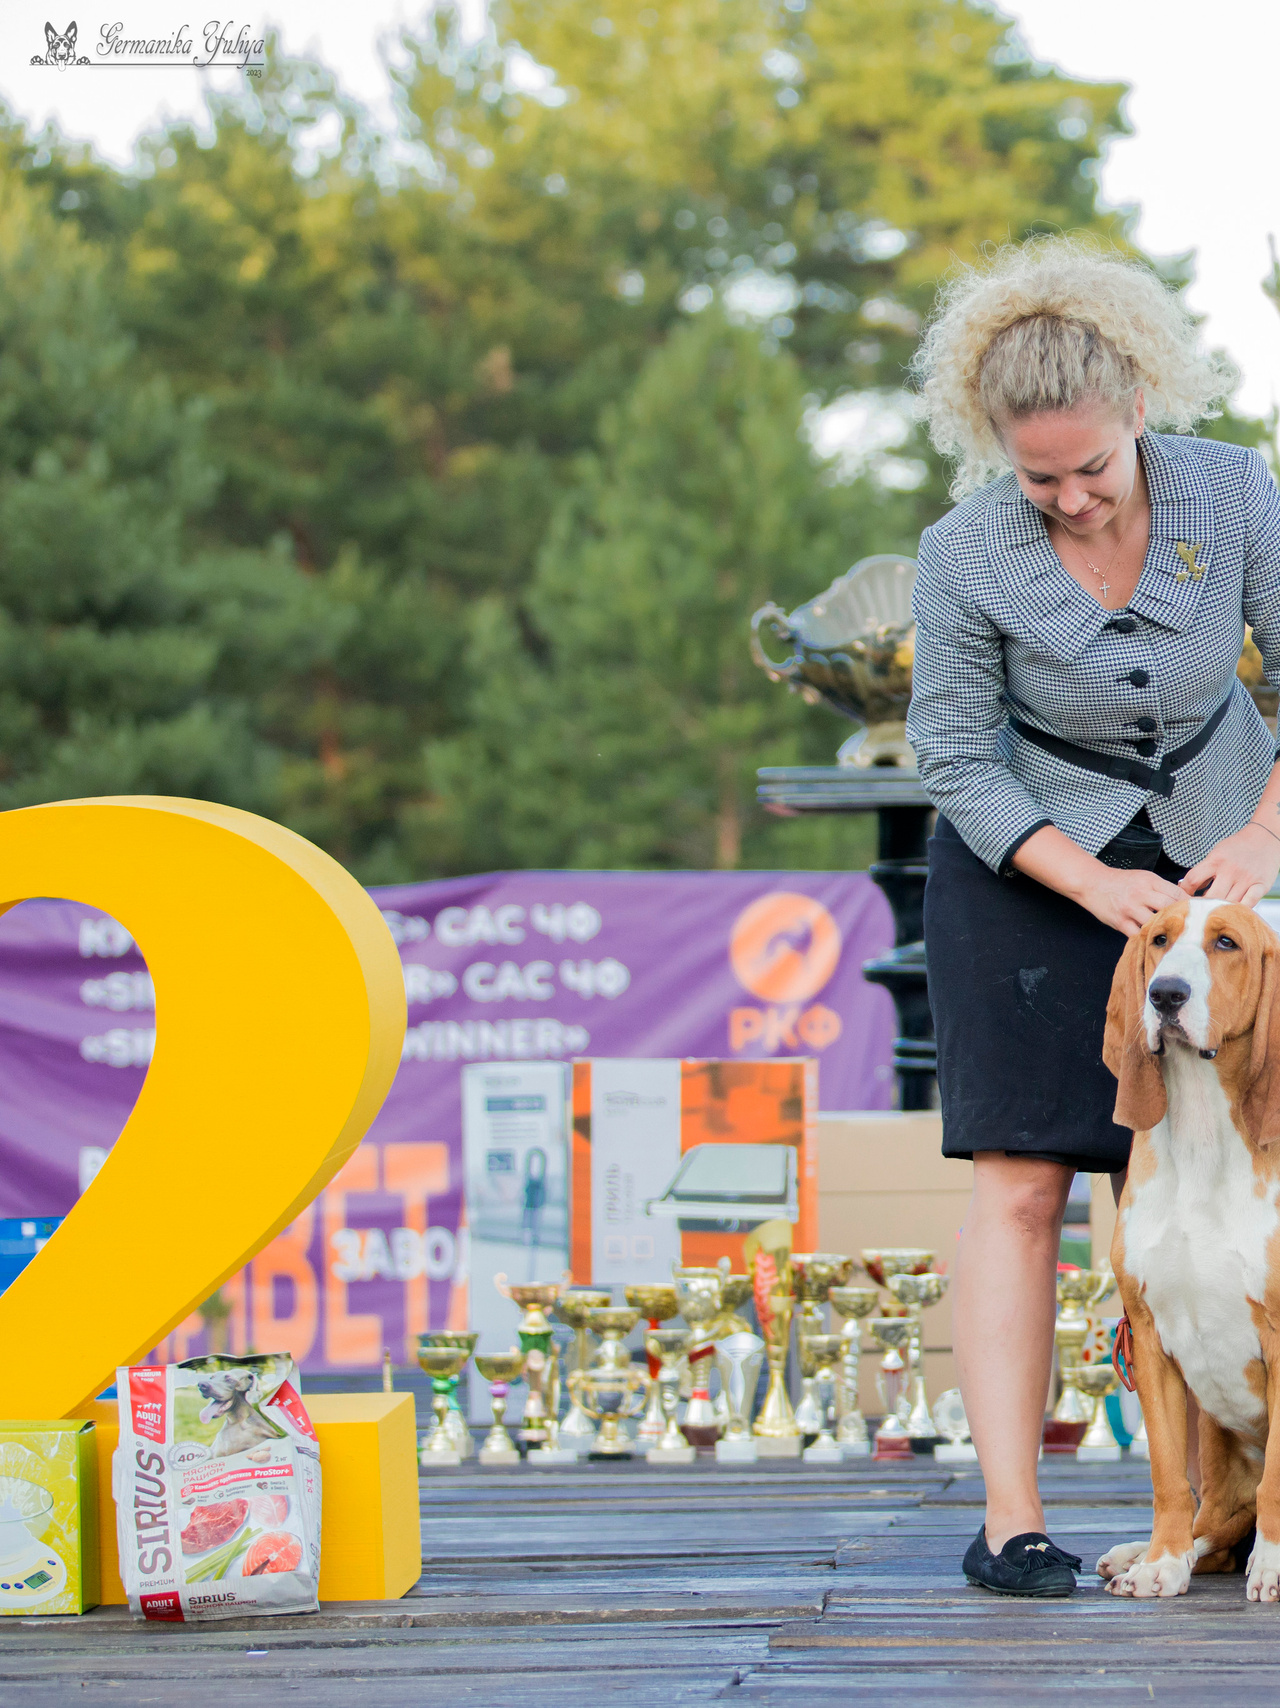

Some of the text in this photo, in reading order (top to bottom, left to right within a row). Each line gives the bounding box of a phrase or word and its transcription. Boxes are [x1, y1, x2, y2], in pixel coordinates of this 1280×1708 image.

[729, 1002, 842, 1053] РКФ
[331, 1225, 470, 1288] ЗАВО
[136, 1410, 162, 1425] ADULT
[177, 1452, 205, 1463] 40%
[183, 1467, 224, 1484] РАЦИОН
[254, 1469, 290, 1477] ProStor+
[134, 1449, 173, 1575] SIRIUS
[140, 1579, 175, 1588] PREMIUM
[146, 1599, 174, 1608] ADULT
[189, 1593, 236, 1605] SIRIUS
